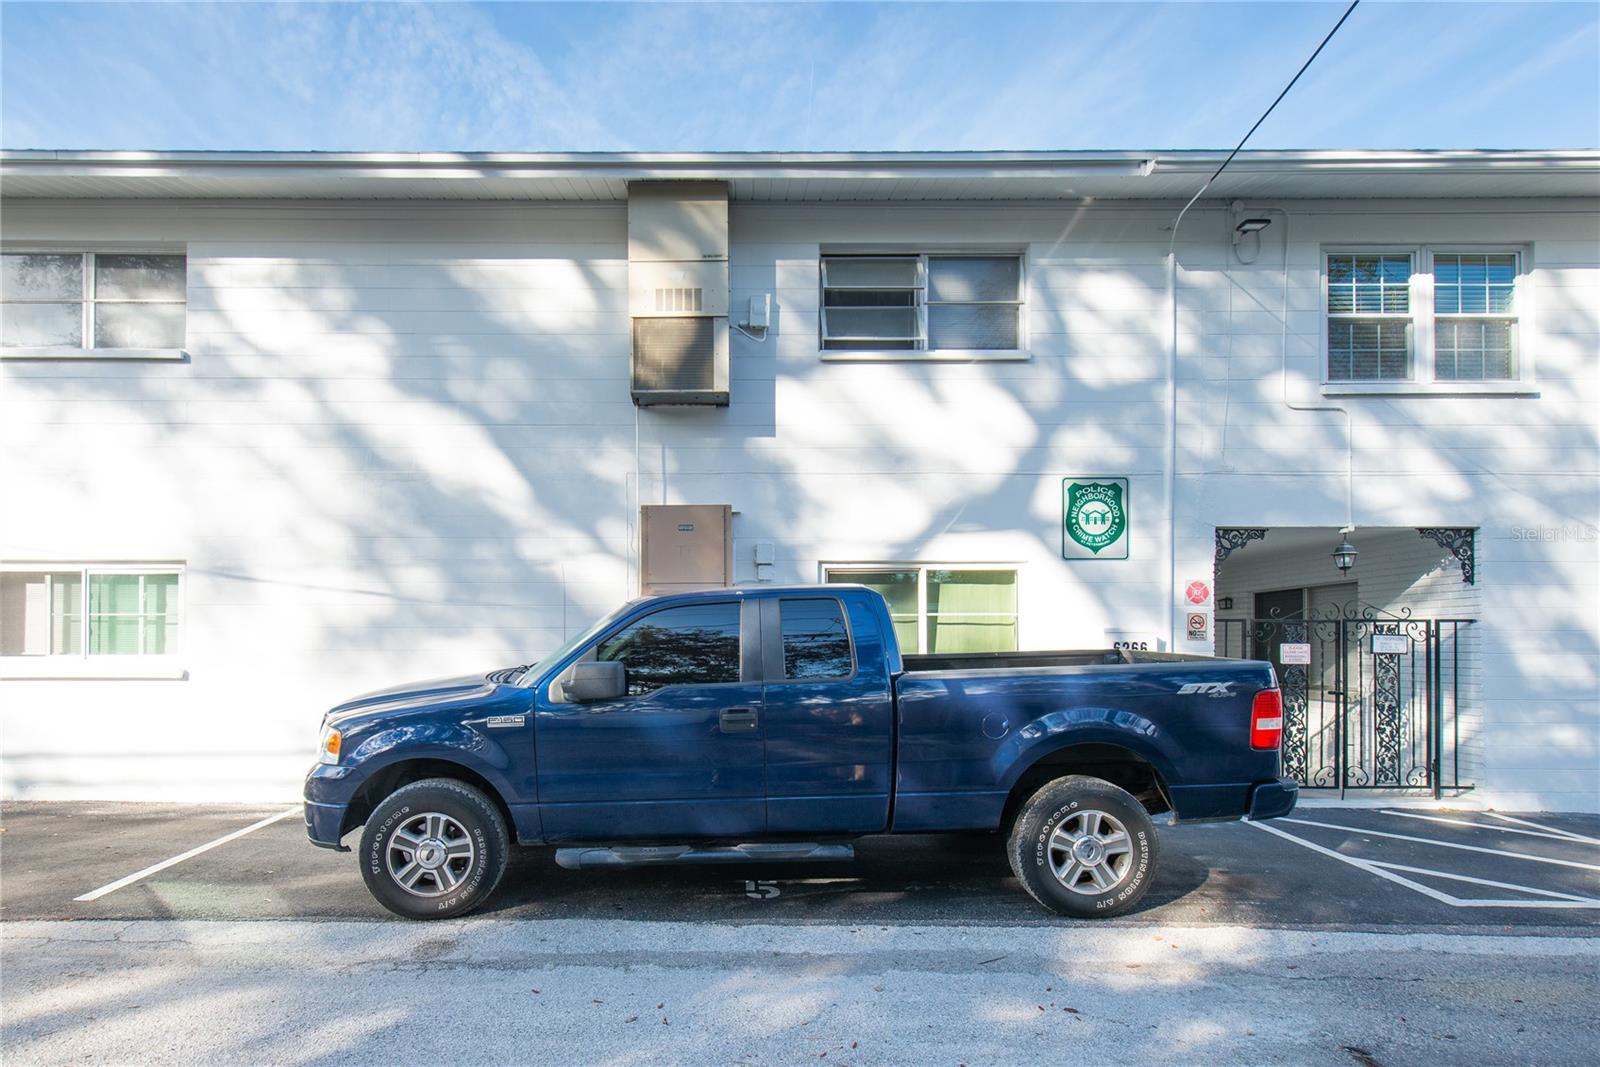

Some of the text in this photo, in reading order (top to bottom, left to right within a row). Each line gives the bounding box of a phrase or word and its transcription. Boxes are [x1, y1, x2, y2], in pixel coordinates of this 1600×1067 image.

[1075, 486, 1116, 498] POLICE
[1071, 492, 1120, 518] NEIGHBORHOOD
[1072, 524, 1094, 543] CRIME
[1094, 524, 1118, 543] WATCH
[1176, 681, 1233, 695] STX
[1096, 831, 1149, 909] DESTINATION A/T
